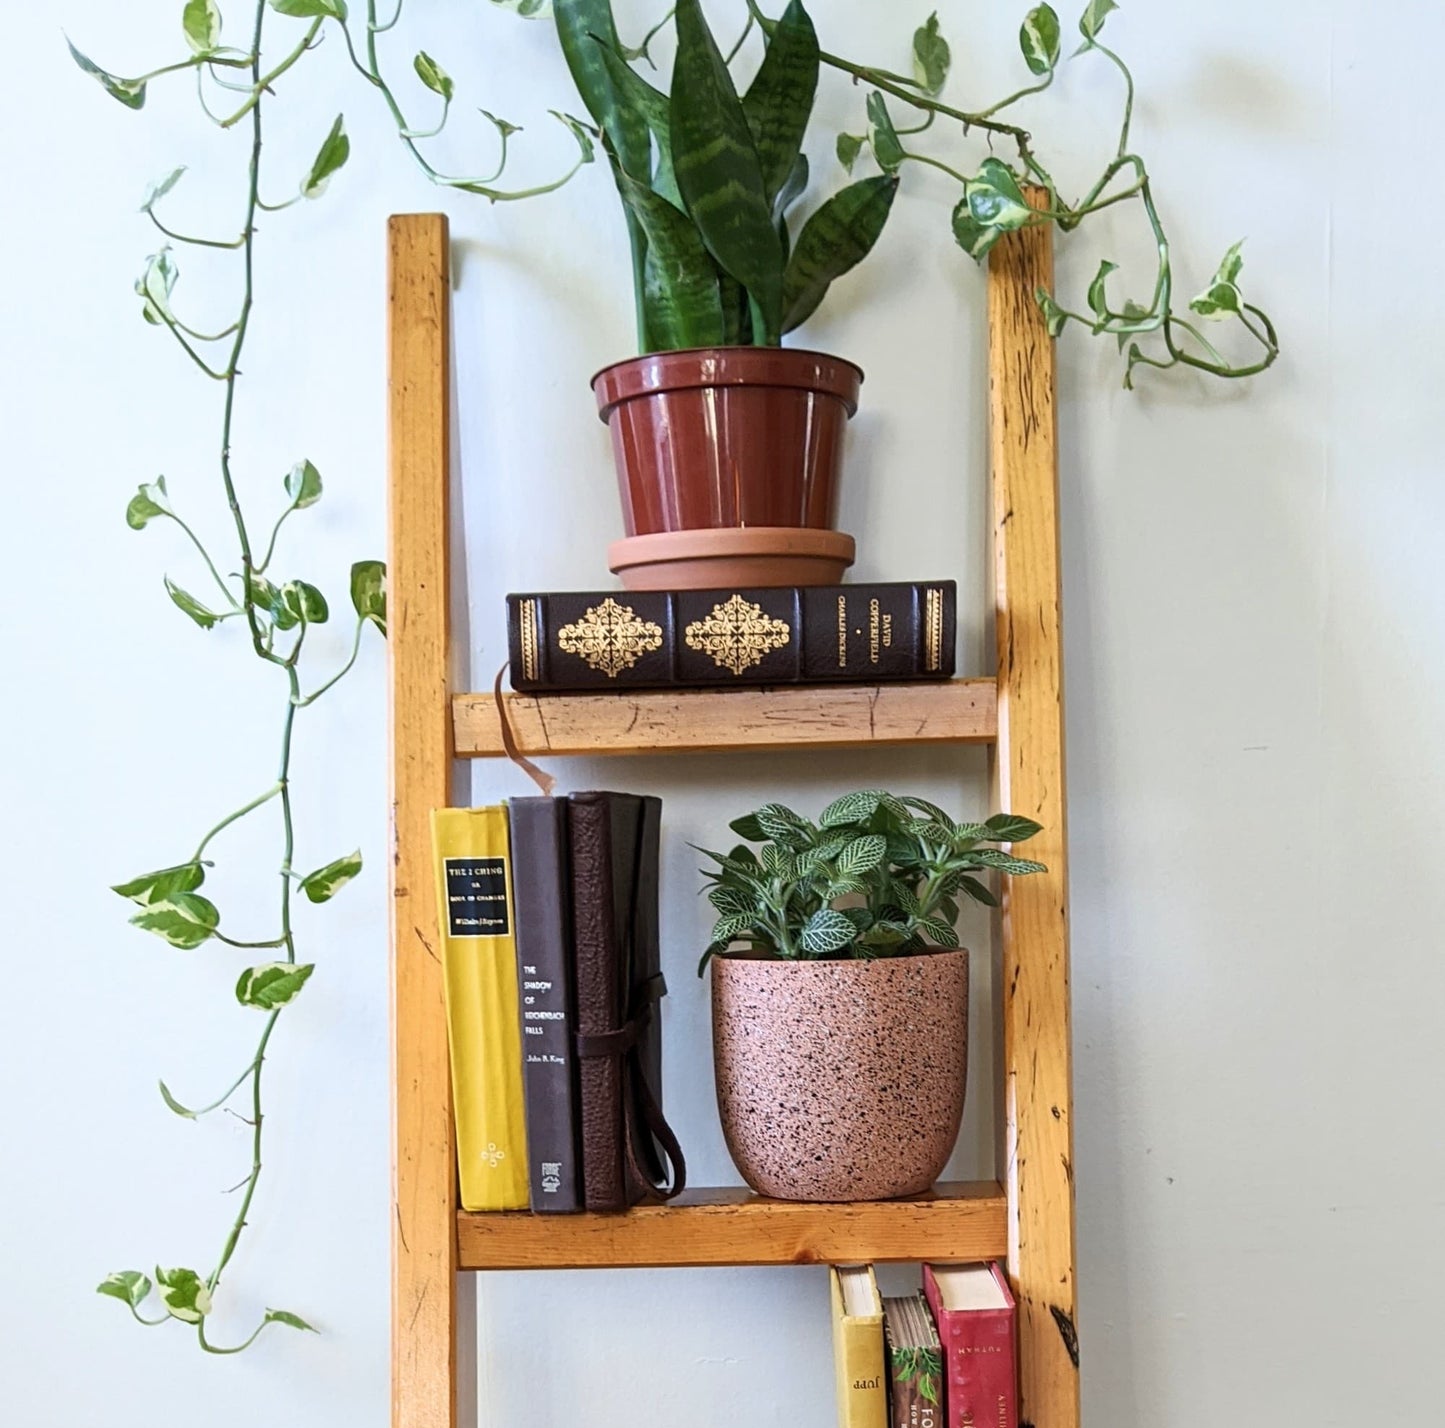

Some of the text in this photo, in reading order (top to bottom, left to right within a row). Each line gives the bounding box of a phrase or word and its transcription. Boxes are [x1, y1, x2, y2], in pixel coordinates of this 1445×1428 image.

[838, 595, 847, 667] CHARLES DICKENS
[870, 598, 880, 664] COPPERFIELD
[882, 614, 891, 647] DAVID
[448, 868, 467, 876] THE
[474, 867, 503, 876] CHING
[523, 966, 536, 975] THE
[524, 981, 552, 990] SHADOW
[524, 996, 535, 1004] OF
[525, 1026, 543, 1035] FALLS
[526, 1055, 541, 1063] John
[549, 1055, 565, 1065] King
[853, 1375, 880, 1390] JUPP
[910, 1404, 918, 1426] HOW
